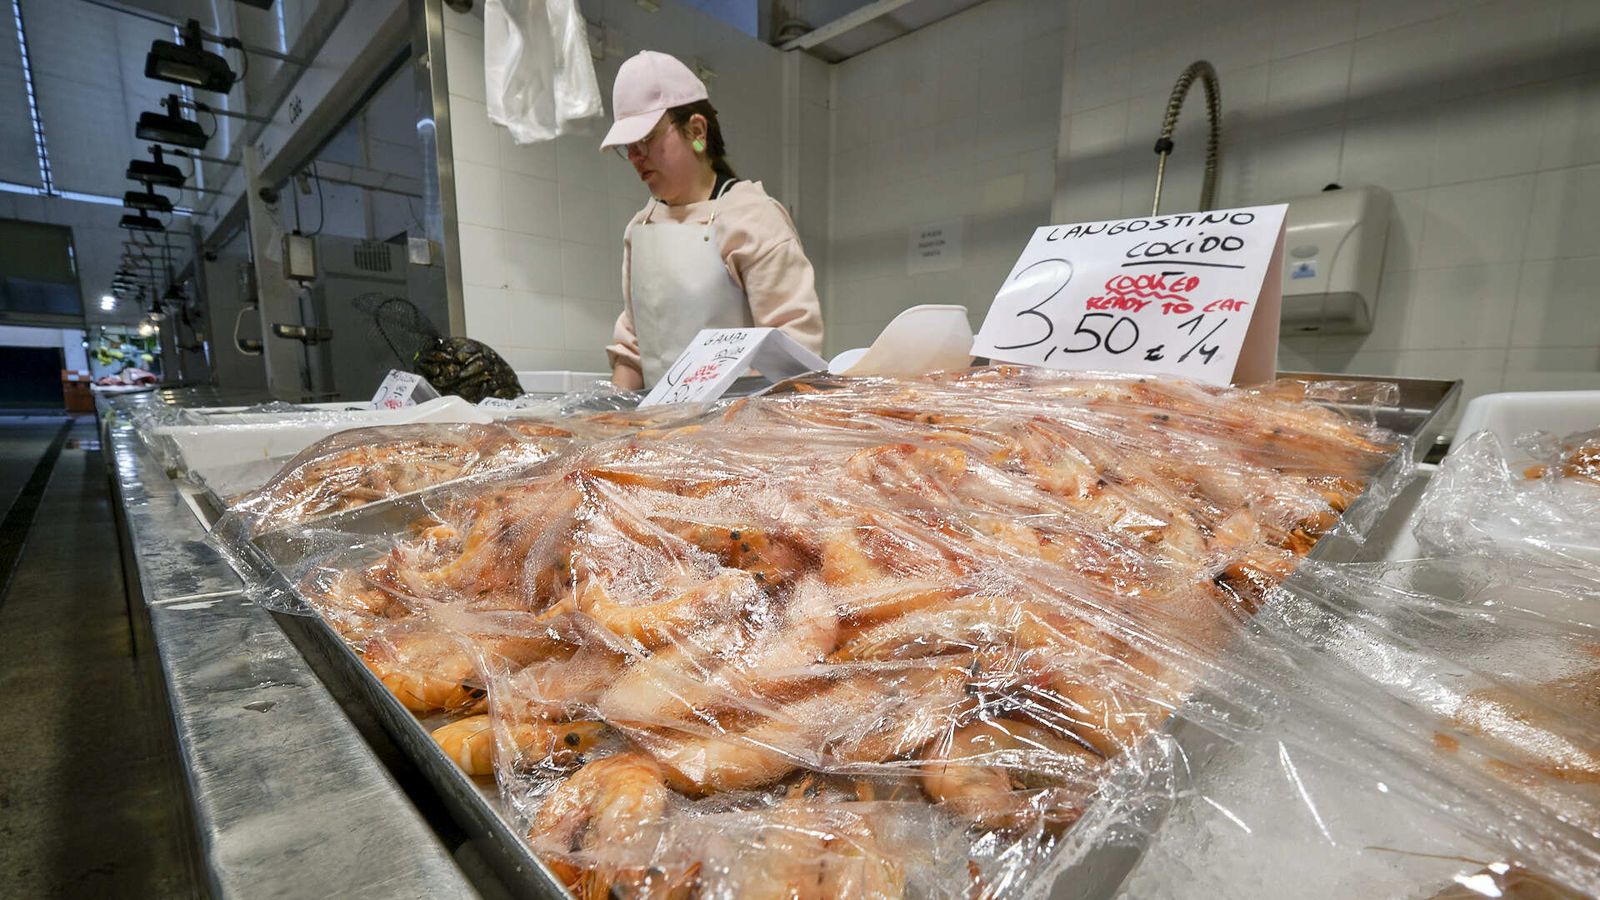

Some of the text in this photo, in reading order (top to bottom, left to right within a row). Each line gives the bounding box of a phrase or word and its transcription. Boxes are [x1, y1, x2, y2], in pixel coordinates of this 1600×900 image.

[1046, 211, 1255, 242] LANGOSTINO
[1126, 232, 1245, 258] COCIDO
[1104, 273, 1200, 296] COOKED
[1086, 296, 1152, 312] READY
[1161, 301, 1194, 316] TO
